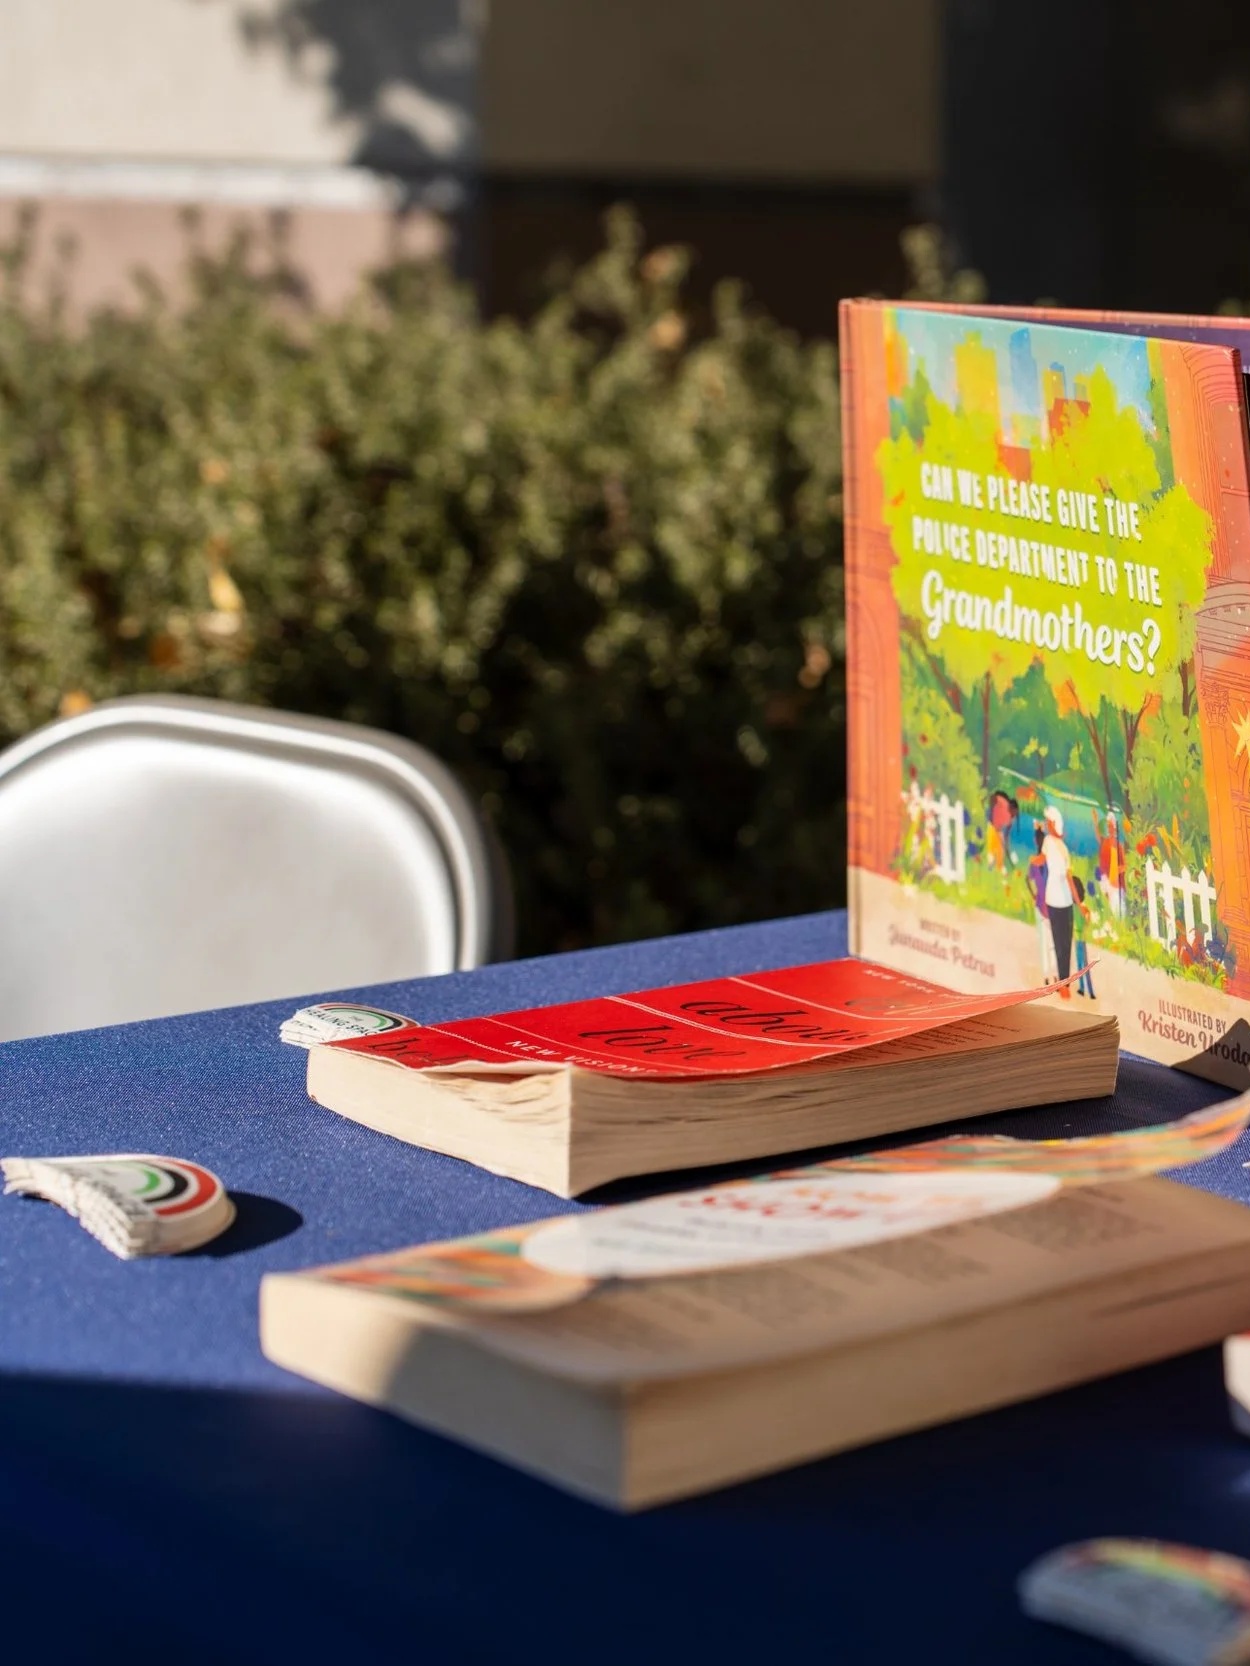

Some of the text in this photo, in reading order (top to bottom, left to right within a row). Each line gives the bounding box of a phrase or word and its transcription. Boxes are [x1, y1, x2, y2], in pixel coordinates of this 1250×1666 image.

[920, 462, 1142, 543] CAN WE PLEASE GIVE THE
[912, 516, 1163, 608] POLICE DEPARTMENT TO THE
[920, 569, 1162, 677] Grandmothers?
[1138, 1009, 1198, 1049] Kristen
[1158, 999, 1227, 1036] ILLUSTRATED BY
[505, 1039, 562, 1057] NEW
